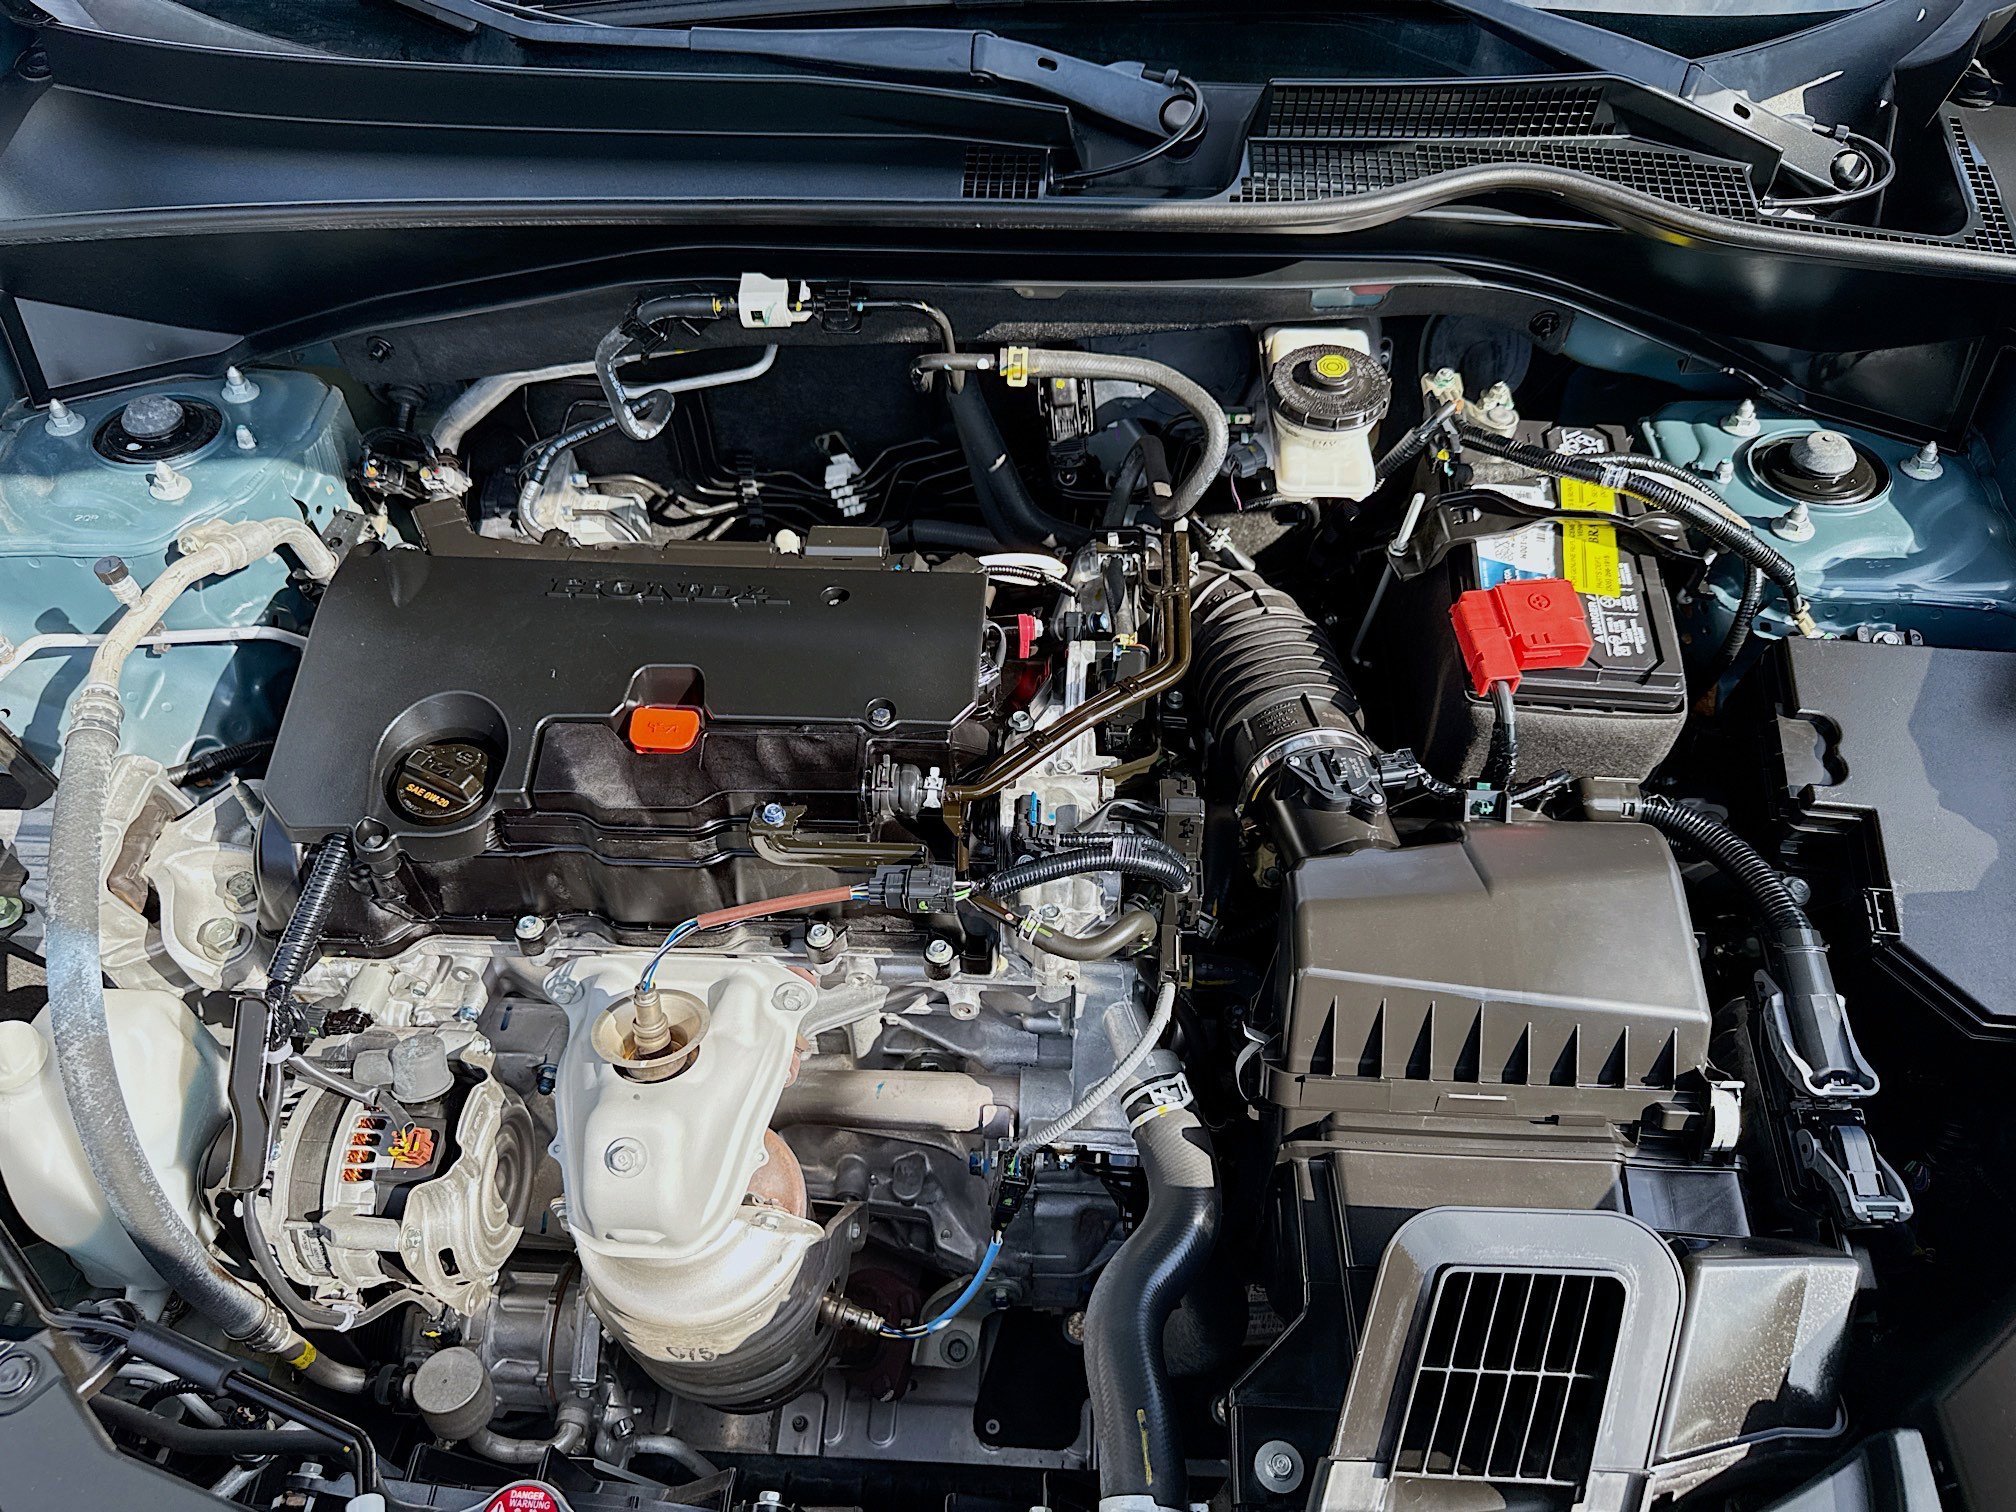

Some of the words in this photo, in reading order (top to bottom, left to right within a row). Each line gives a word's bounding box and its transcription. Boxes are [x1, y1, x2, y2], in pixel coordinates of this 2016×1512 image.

[545, 578, 790, 606] HONDA
[406, 783, 426, 796] SAE
[423, 791, 450, 808] 0W-20
[510, 1489, 545, 1500] DANGER
[509, 1498, 550, 1510] WARNUNG
